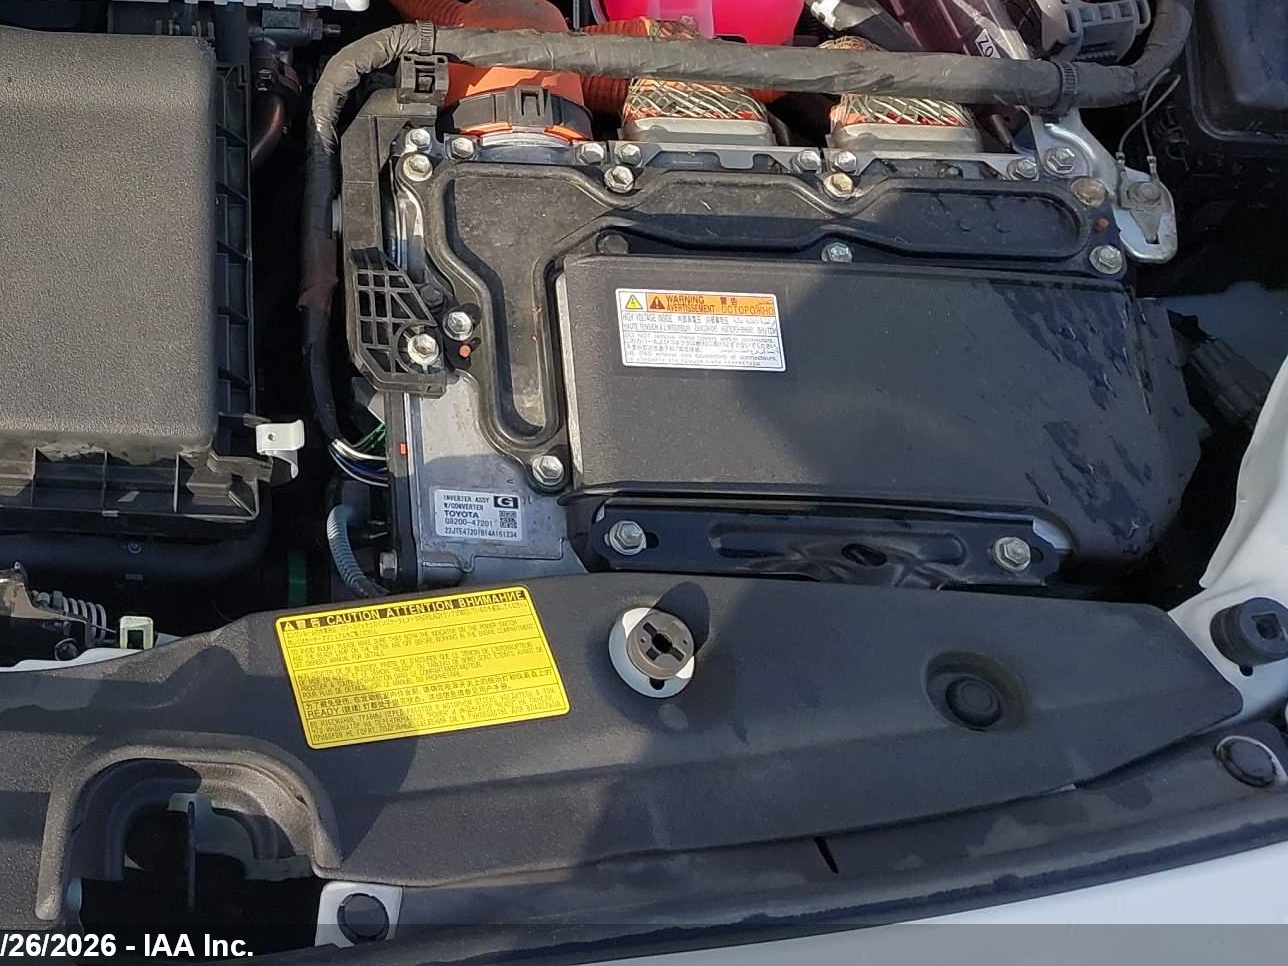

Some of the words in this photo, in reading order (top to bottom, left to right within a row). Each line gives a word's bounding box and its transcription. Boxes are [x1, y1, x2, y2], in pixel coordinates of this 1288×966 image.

[666, 295, 705, 305] WARNING
[667, 303, 715, 314] AVERTISSEMENT
[443, 494, 472, 503] INVERTER
[444, 510, 479, 518] TOYOTA
[458, 590, 525, 608] ВНИМАНИЕ
[326, 610, 381, 626] CAUTION
[386, 600, 454, 618] ATTENTION
[307, 707, 340, 718] READY
